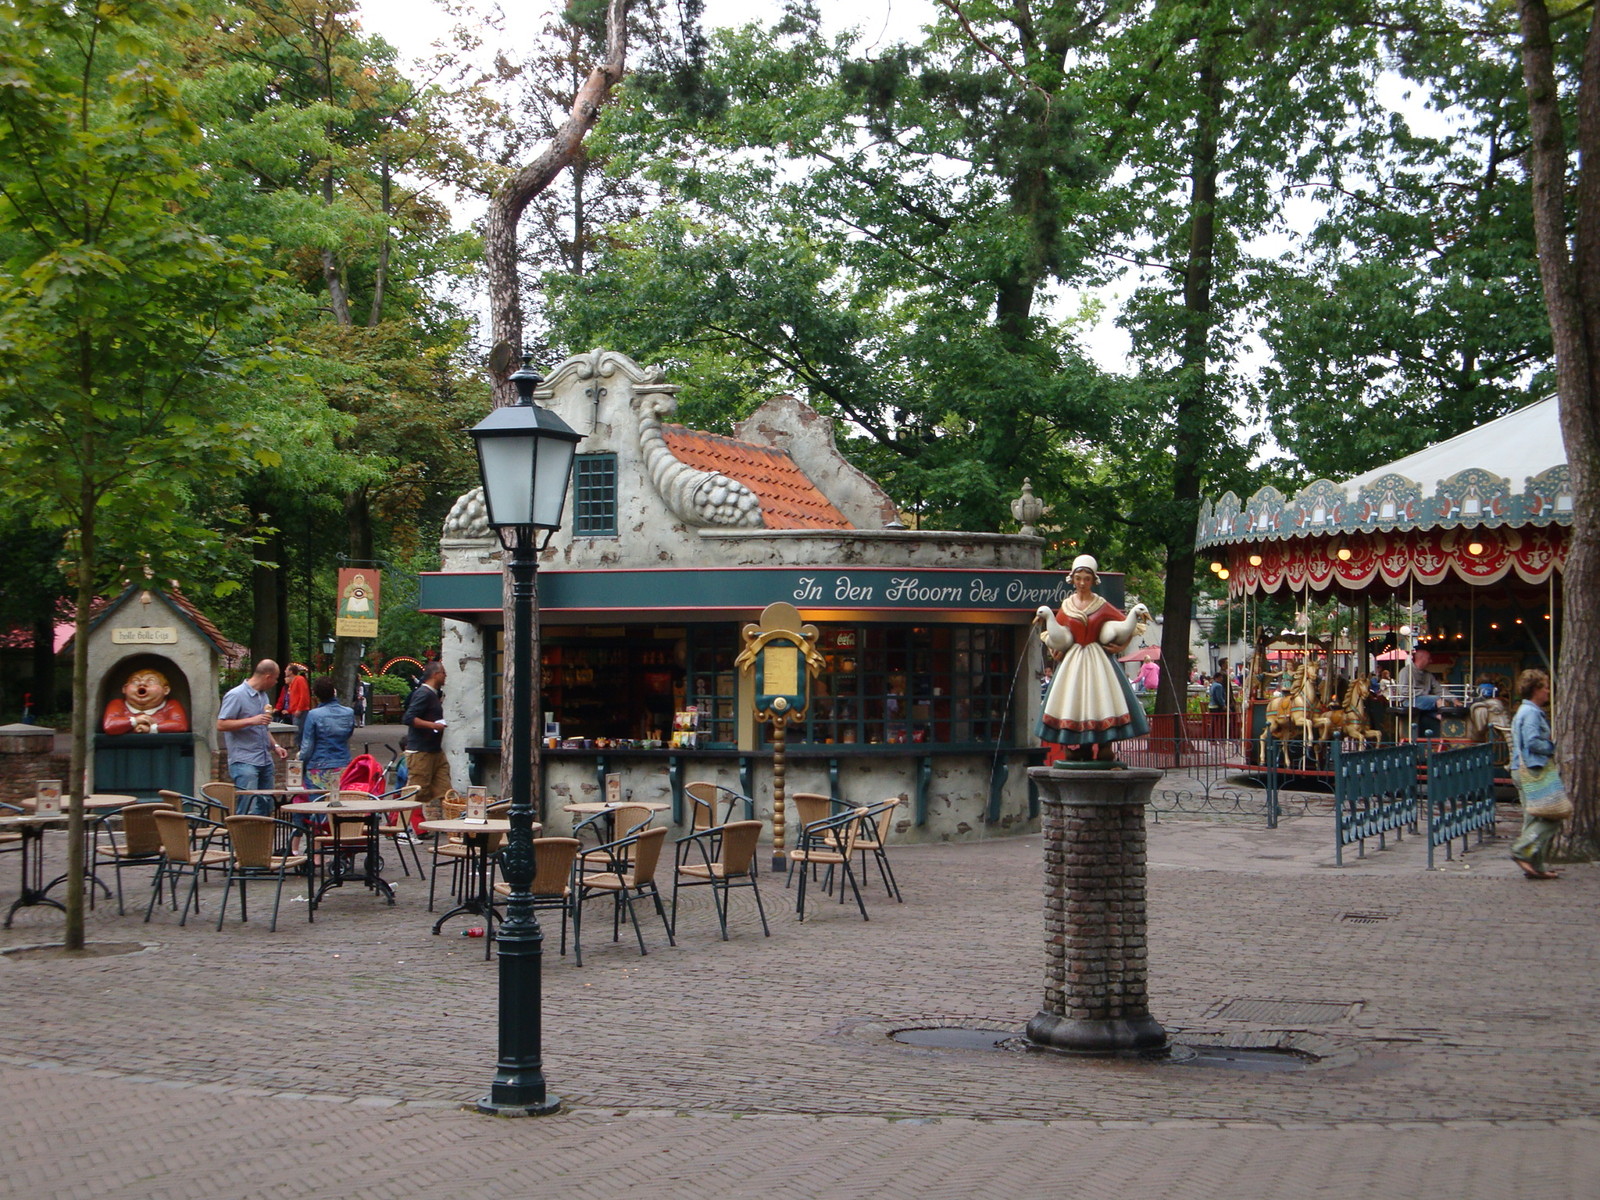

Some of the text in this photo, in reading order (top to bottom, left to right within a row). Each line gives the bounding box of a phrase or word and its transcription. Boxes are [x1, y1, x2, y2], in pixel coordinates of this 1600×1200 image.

[793, 576, 1077, 602] In den Hoorn des Overvlo
